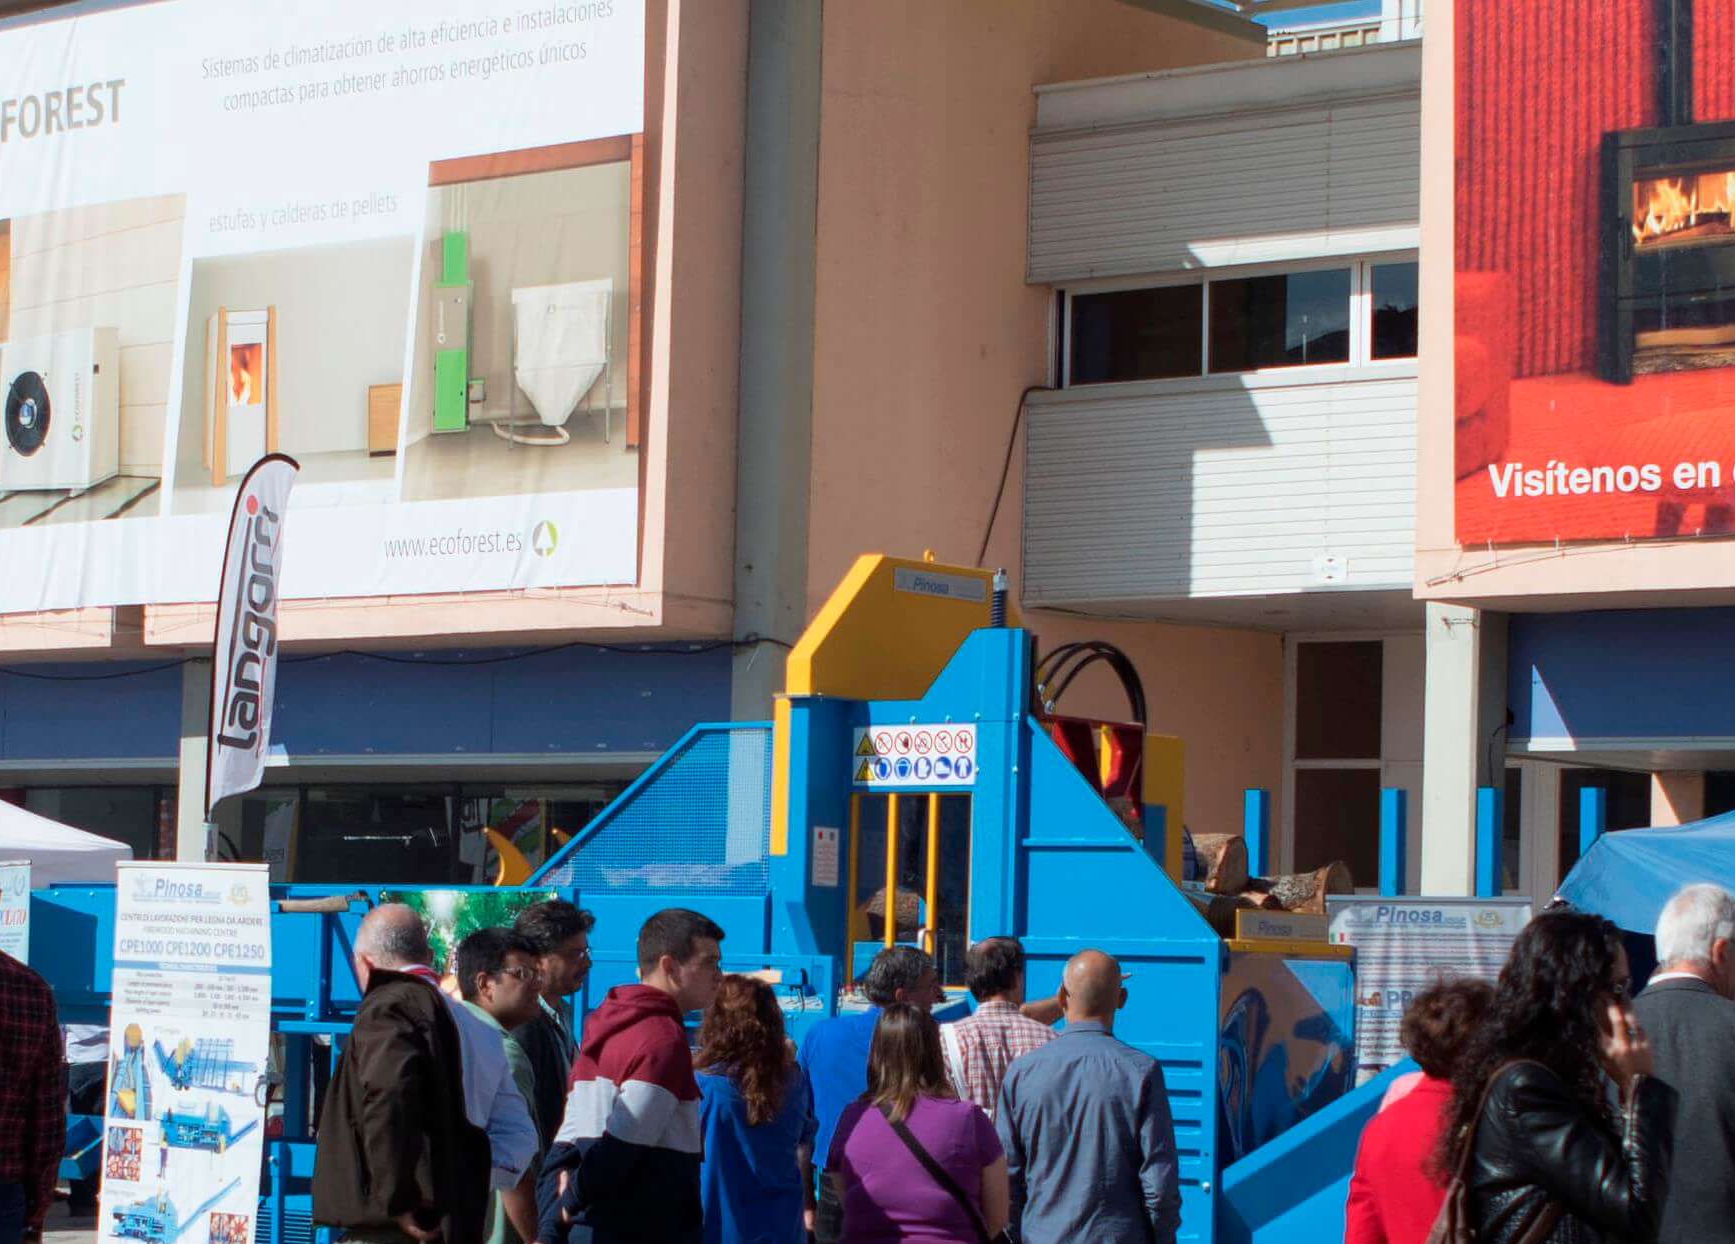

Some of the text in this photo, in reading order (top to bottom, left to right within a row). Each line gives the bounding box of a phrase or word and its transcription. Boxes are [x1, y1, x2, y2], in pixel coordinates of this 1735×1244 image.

[201, 54, 259, 79] Sistemas
[264, 52, 279, 71] de
[377, 33, 394, 53] de
[399, 28, 426, 50] alta
[430, 18, 497, 45] eficiencia
[503, 18, 512, 32] e
[516, 1, 614, 32] instalaciones
[223, 83, 294, 112] compactas
[299, 79, 329, 104] para
[333, 71, 387, 96] obtener
[392, 62, 445, 88] ahorros
[539, 40, 587, 66] únicos
[209, 208, 256, 232] estufas
[271, 201, 327, 225] calderas
[331, 199, 347, 217] de
[352, 192, 398, 220] pellets
[1488, 452, 1662, 499] Visítenos
[1673, 458, 1718, 490] en
[384, 528, 522, 560] www.ecoforest.es
